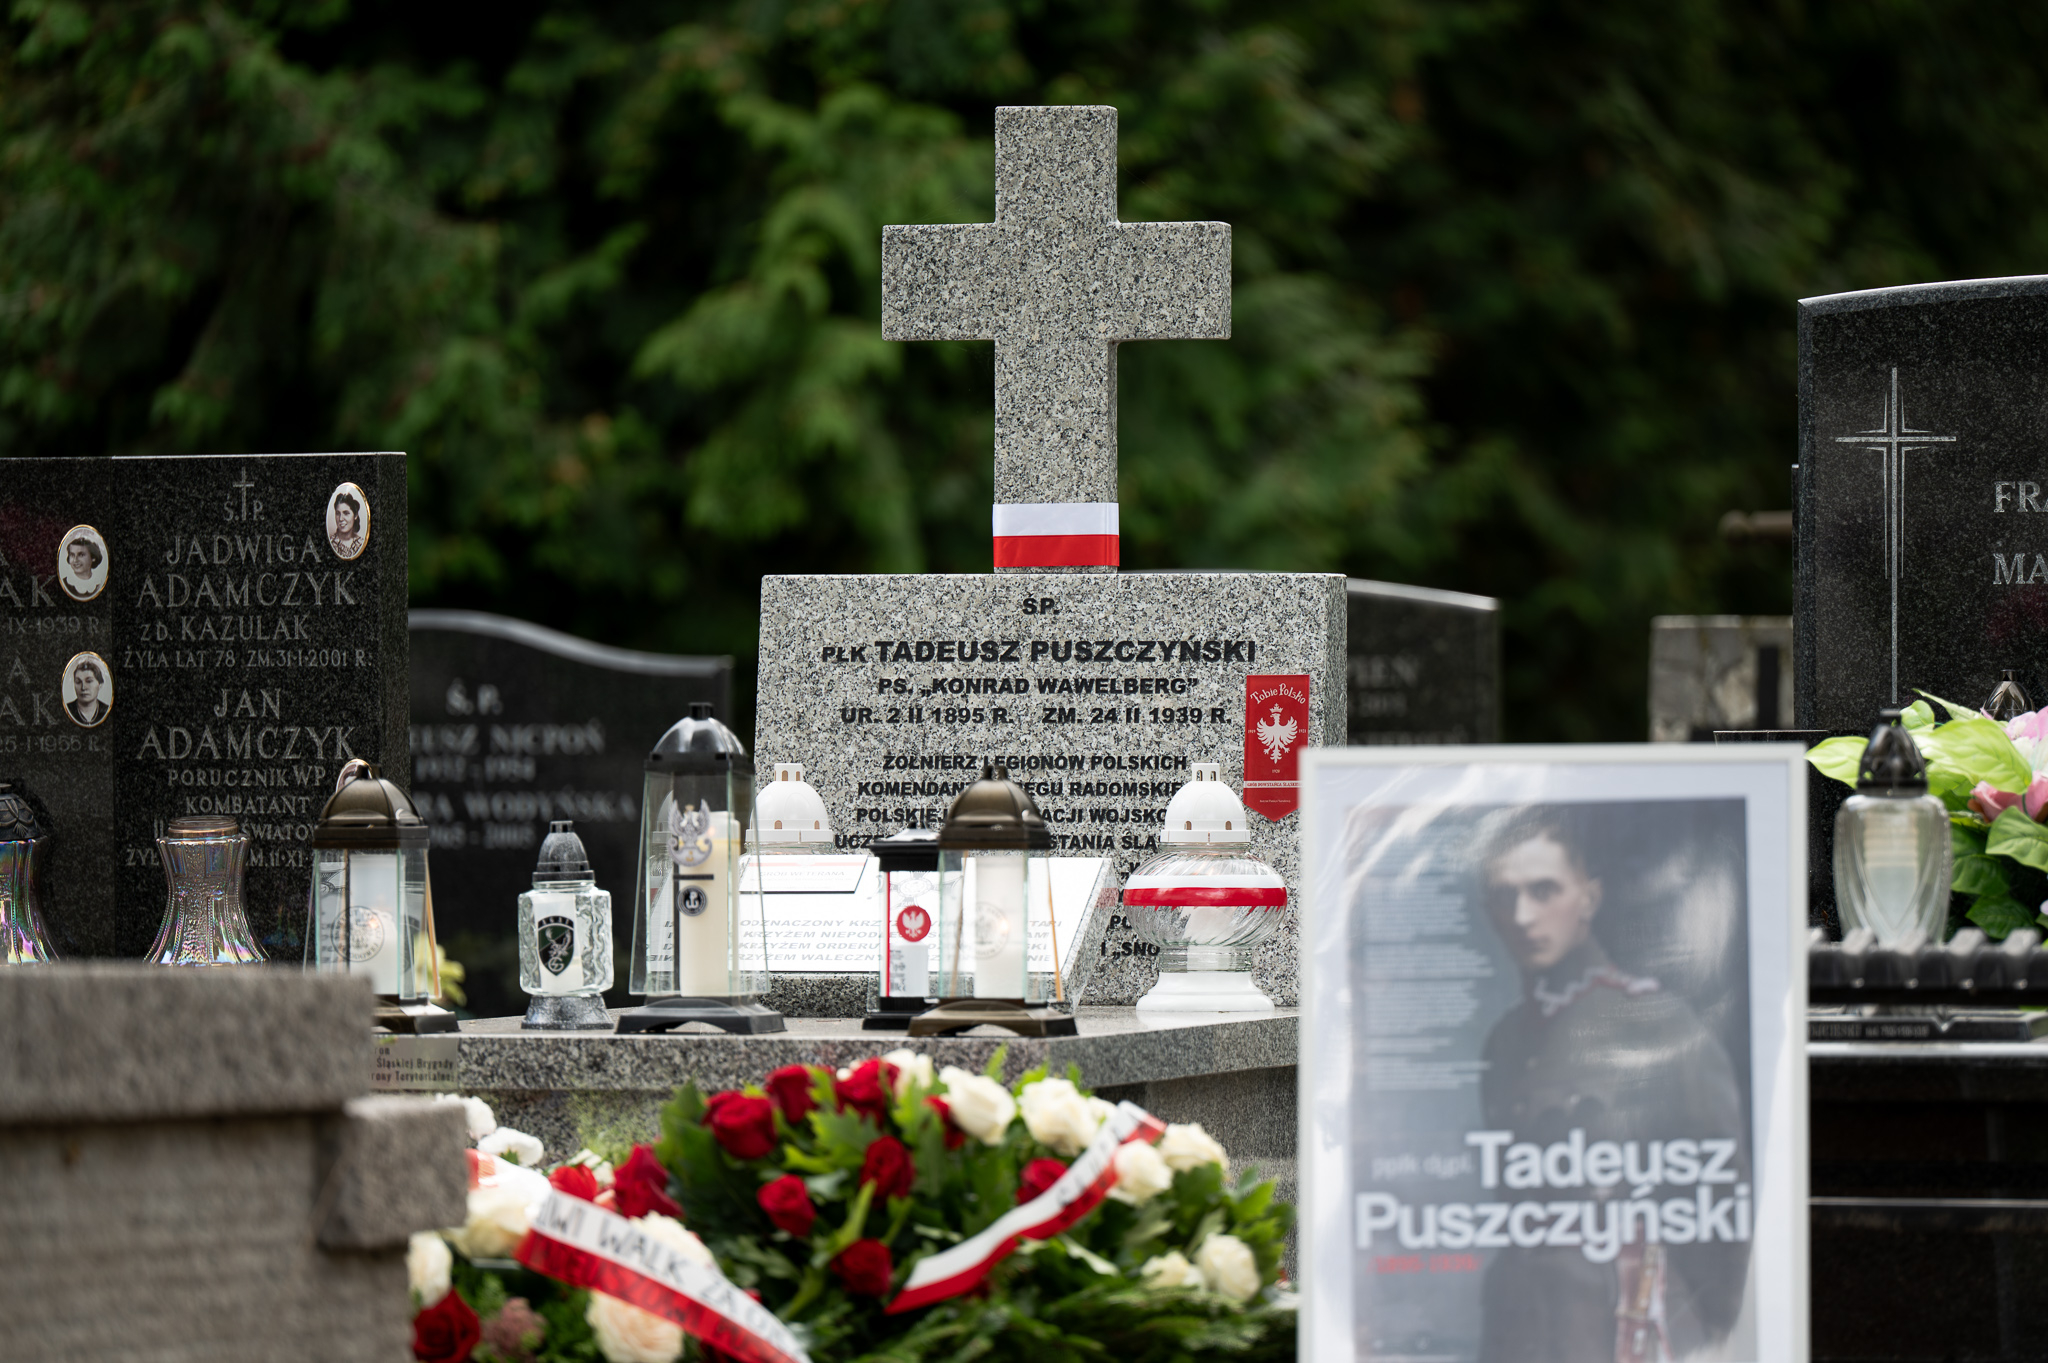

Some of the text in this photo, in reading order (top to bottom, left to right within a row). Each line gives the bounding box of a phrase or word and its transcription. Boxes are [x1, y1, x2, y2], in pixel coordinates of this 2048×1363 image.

[1994, 481, 2048, 513] FR
[167, 534, 322, 565] JADWIGA
[135, 571, 358, 608] ADAMCZYK
[181, 611, 310, 641] KAZULAK
[176, 651, 205, 667] LAT
[215, 650, 236, 667] 78
[822, 635, 1256, 662] PŁK TADEUSZ PUSZCZYŃSKI
[878, 678, 914, 694] PS.
[1250, 683, 1306, 705] Tobie Polsko
[213, 687, 281, 720] JAN
[840, 707, 882, 724] UR.
[886, 707, 900, 723] 2
[931, 707, 985, 724] 1895
[992, 707, 1014, 723] R.
[1042, 707, 1083, 724] ZM.
[1090, 707, 1118, 724] 24
[1149, 706, 1203, 724] 1939
[1210, 707, 1232, 723] R.
[135, 724, 357, 760] ADAMCZYK
[883, 752, 978, 770] ŻOŁNIERZ
[1091, 755, 1187, 770] POLSKICH
[167, 764, 327, 787] PORUCZNIK WP
[858, 781, 972, 797] KOMENDAN
[1069, 782, 1183, 797] RADOMSKIE
[185, 794, 311, 816] KOMBATANT
[856, 808, 948, 823] POLSKIEJ
[816, 942, 880, 950] ORDERU
[1464, 1127, 1739, 1190] Tadeusz
[1355, 1182, 1752, 1264] Puszczyński
